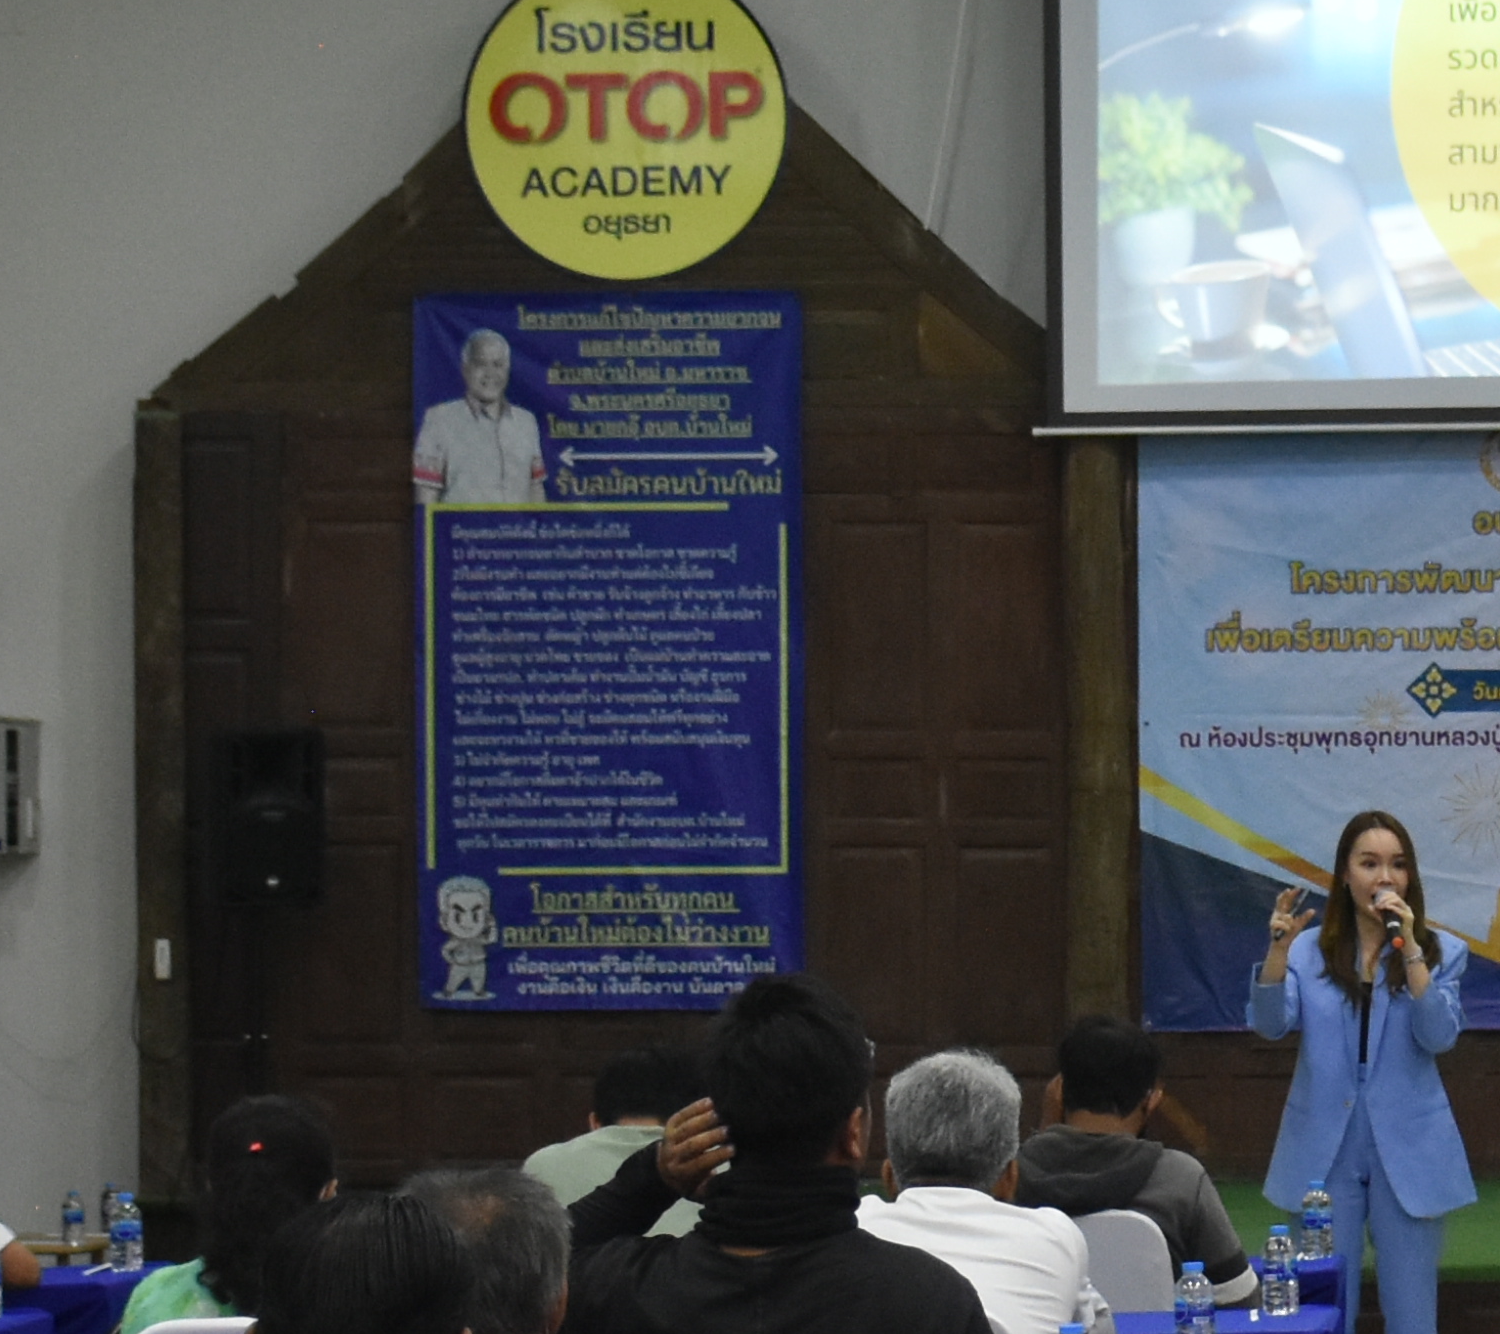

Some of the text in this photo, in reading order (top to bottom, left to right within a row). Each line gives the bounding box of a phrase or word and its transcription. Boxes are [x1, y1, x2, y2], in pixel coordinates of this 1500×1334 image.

[534, 6, 715, 54] โรงเรียน
[488, 70, 766, 144] OTOP
[520, 164, 733, 199] ACADEMY
[582, 213, 673, 241] อยุธยา
